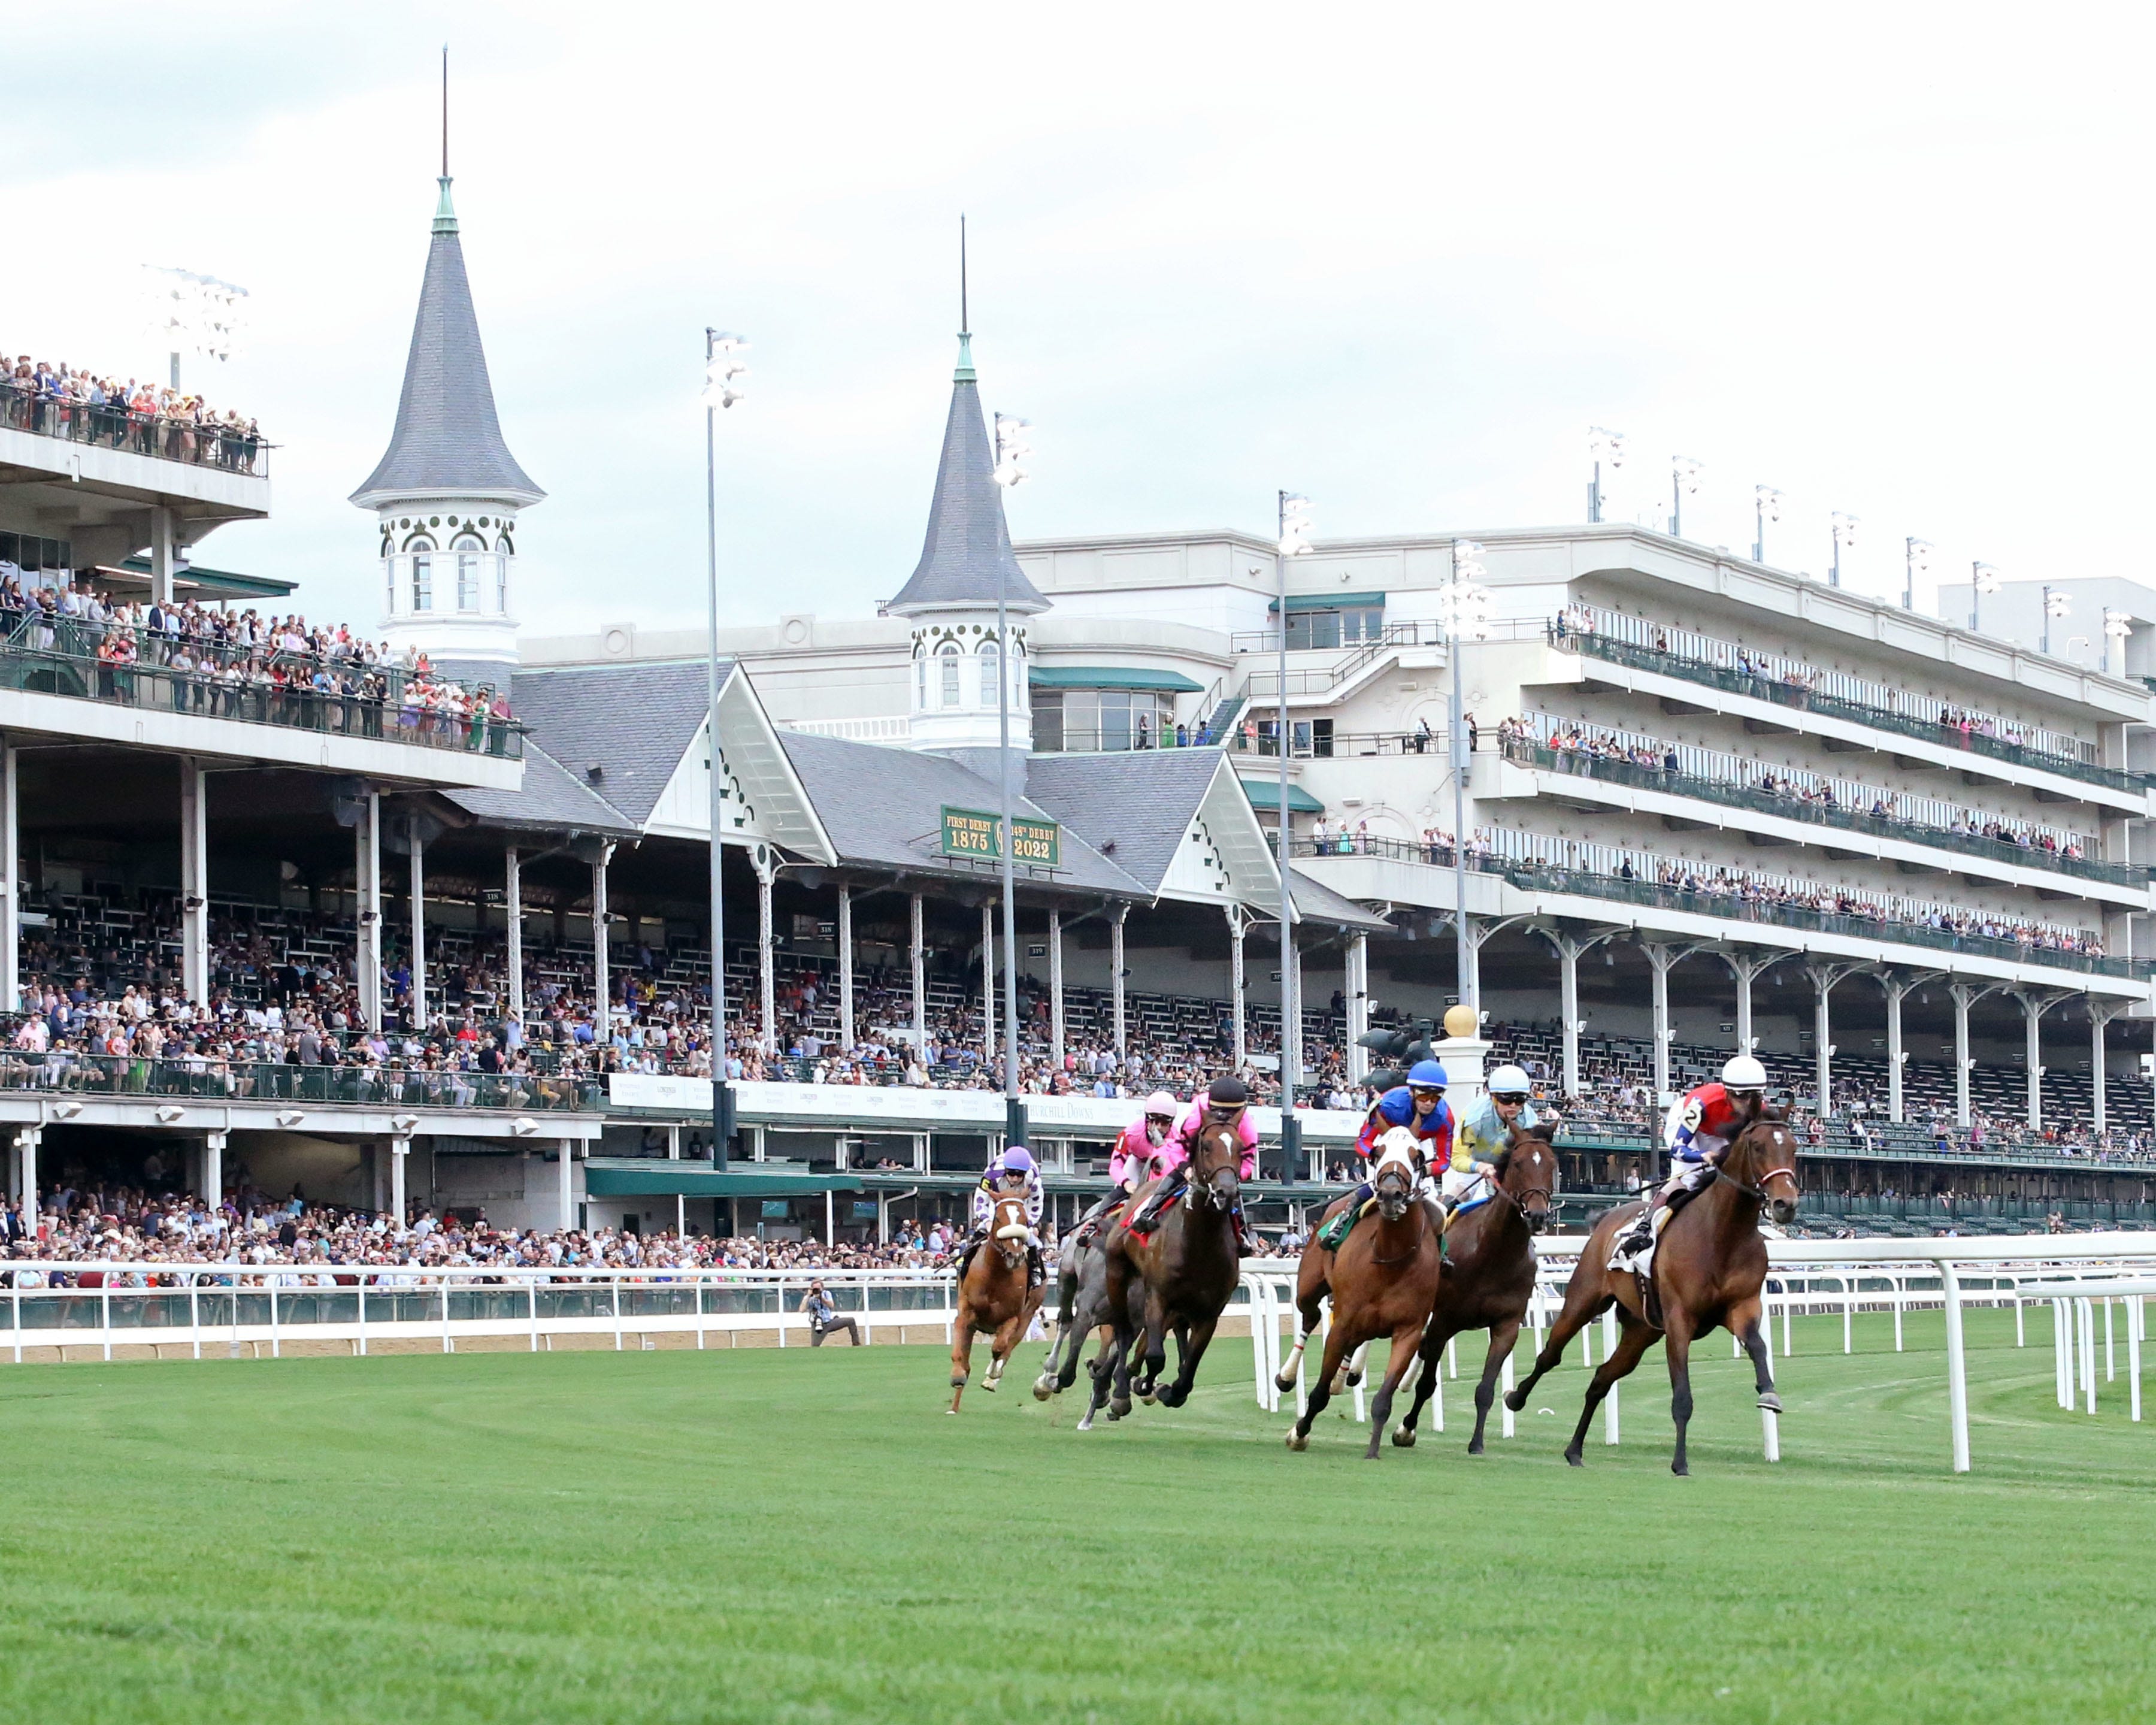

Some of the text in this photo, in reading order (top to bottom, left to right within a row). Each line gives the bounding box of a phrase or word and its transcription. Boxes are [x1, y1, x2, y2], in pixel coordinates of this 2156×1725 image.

[947, 816, 992, 833] FIRST DERBY
[951, 830, 988, 851] 1875
[1029, 827, 1054, 842] DERBY
[1014, 839, 1050, 859] 2022
[1025, 1100, 1065, 1119] HURCHILL
[1684, 1109, 1697, 1127] 2
[1118, 1136, 1125, 1150] 1
